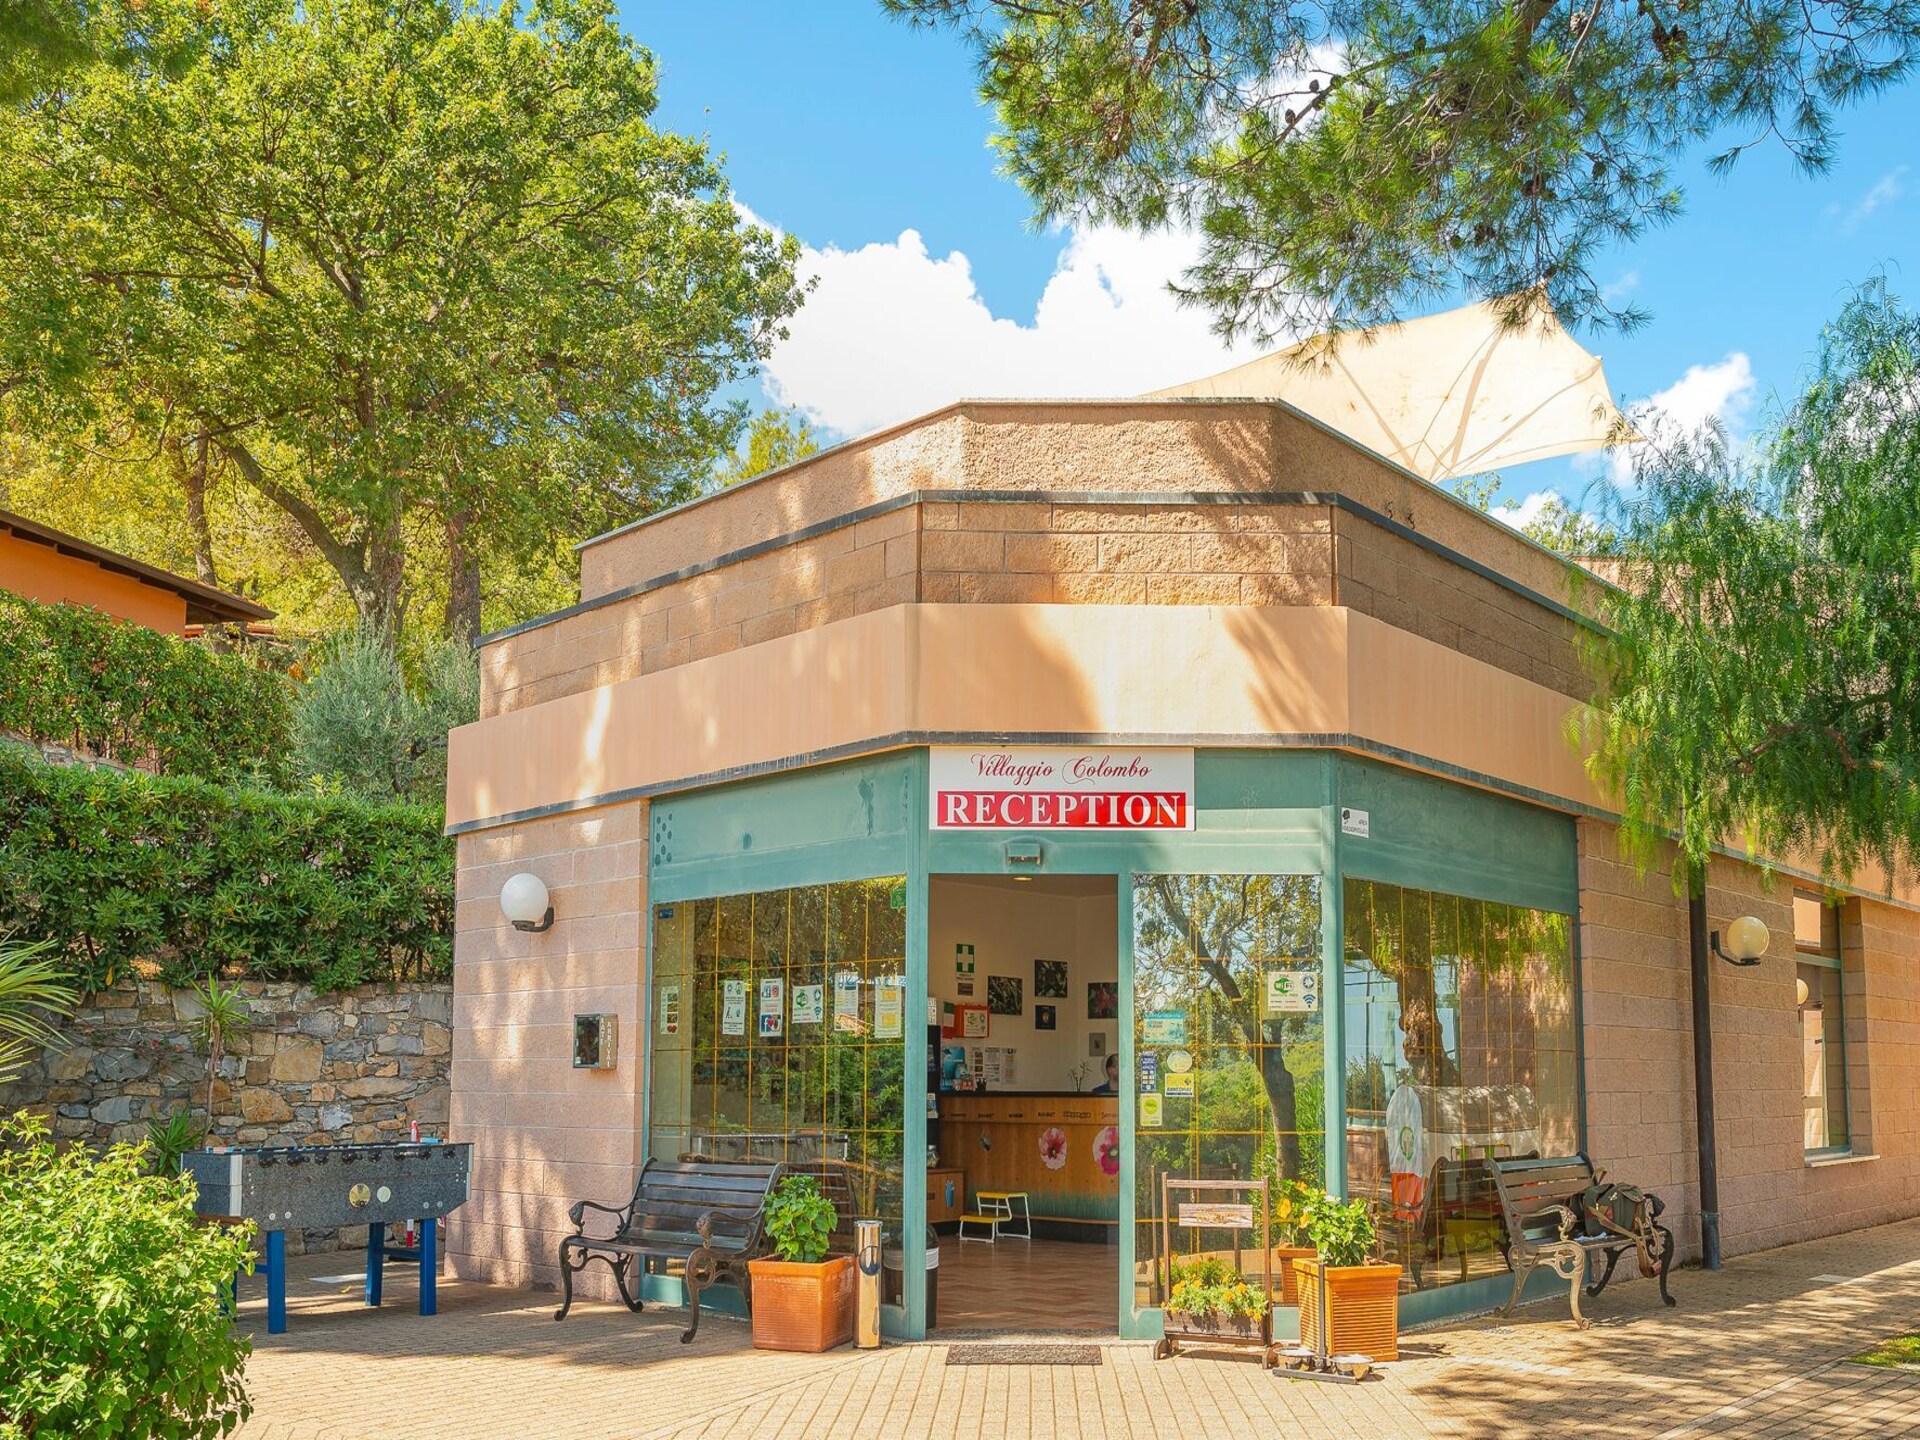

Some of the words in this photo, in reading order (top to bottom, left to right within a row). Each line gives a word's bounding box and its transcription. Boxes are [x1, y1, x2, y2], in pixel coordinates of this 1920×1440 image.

[971, 754, 1055, 786] Villaggio
[1062, 755, 1152, 785] Colombo
[944, 793, 1180, 826] RECEPTION
